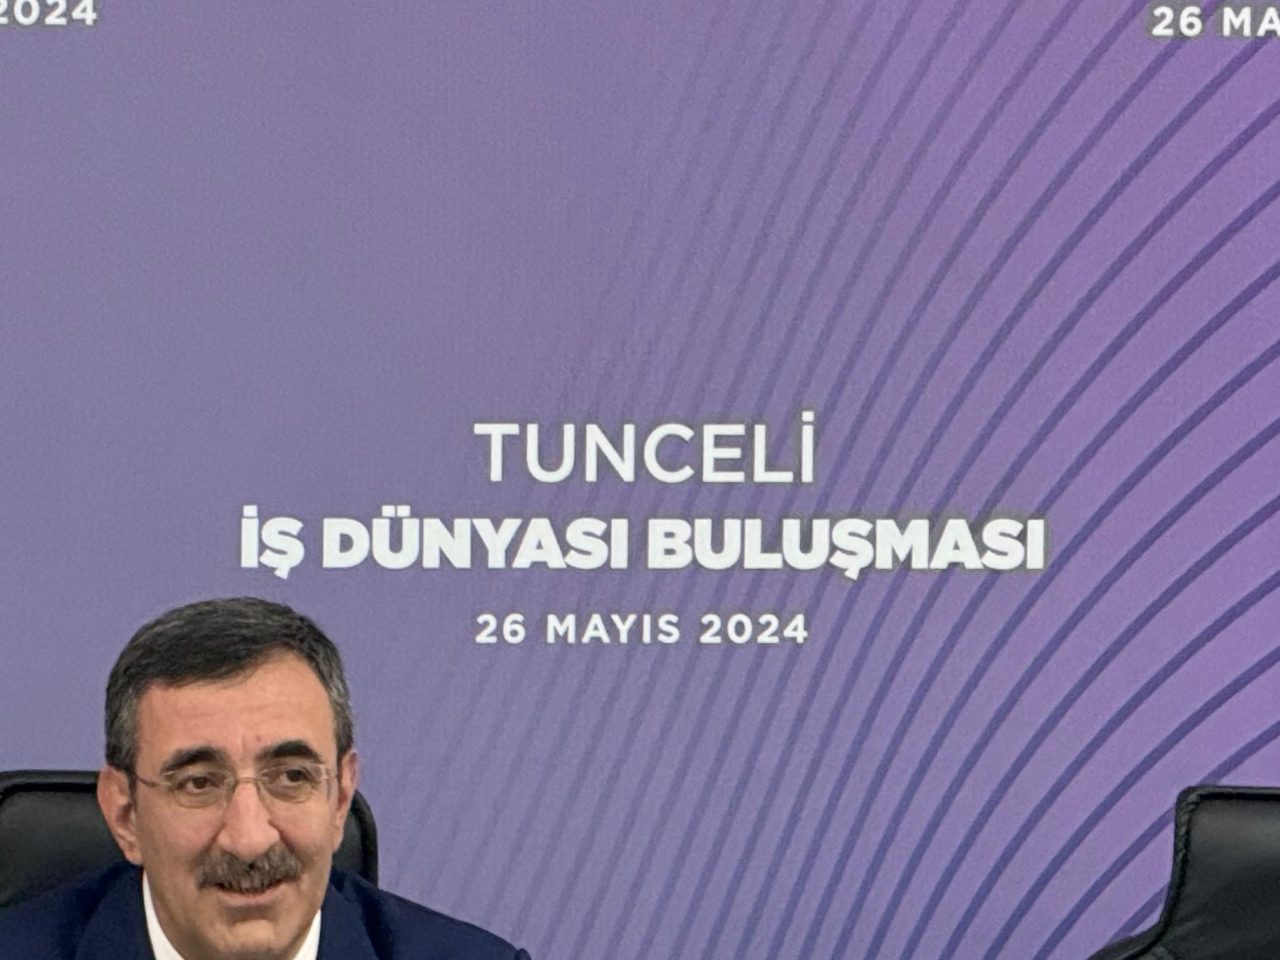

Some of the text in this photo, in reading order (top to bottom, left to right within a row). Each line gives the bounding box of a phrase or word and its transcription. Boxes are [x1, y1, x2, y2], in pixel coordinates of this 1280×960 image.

[1151, 5, 1280, 37] 26 MA
[473, 410, 815, 484] TUNCELİ
[240, 504, 1045, 581] İŞ DÜNYASI BULUŞMASI
[475, 613, 809, 644] 26 MAYIS 2024
